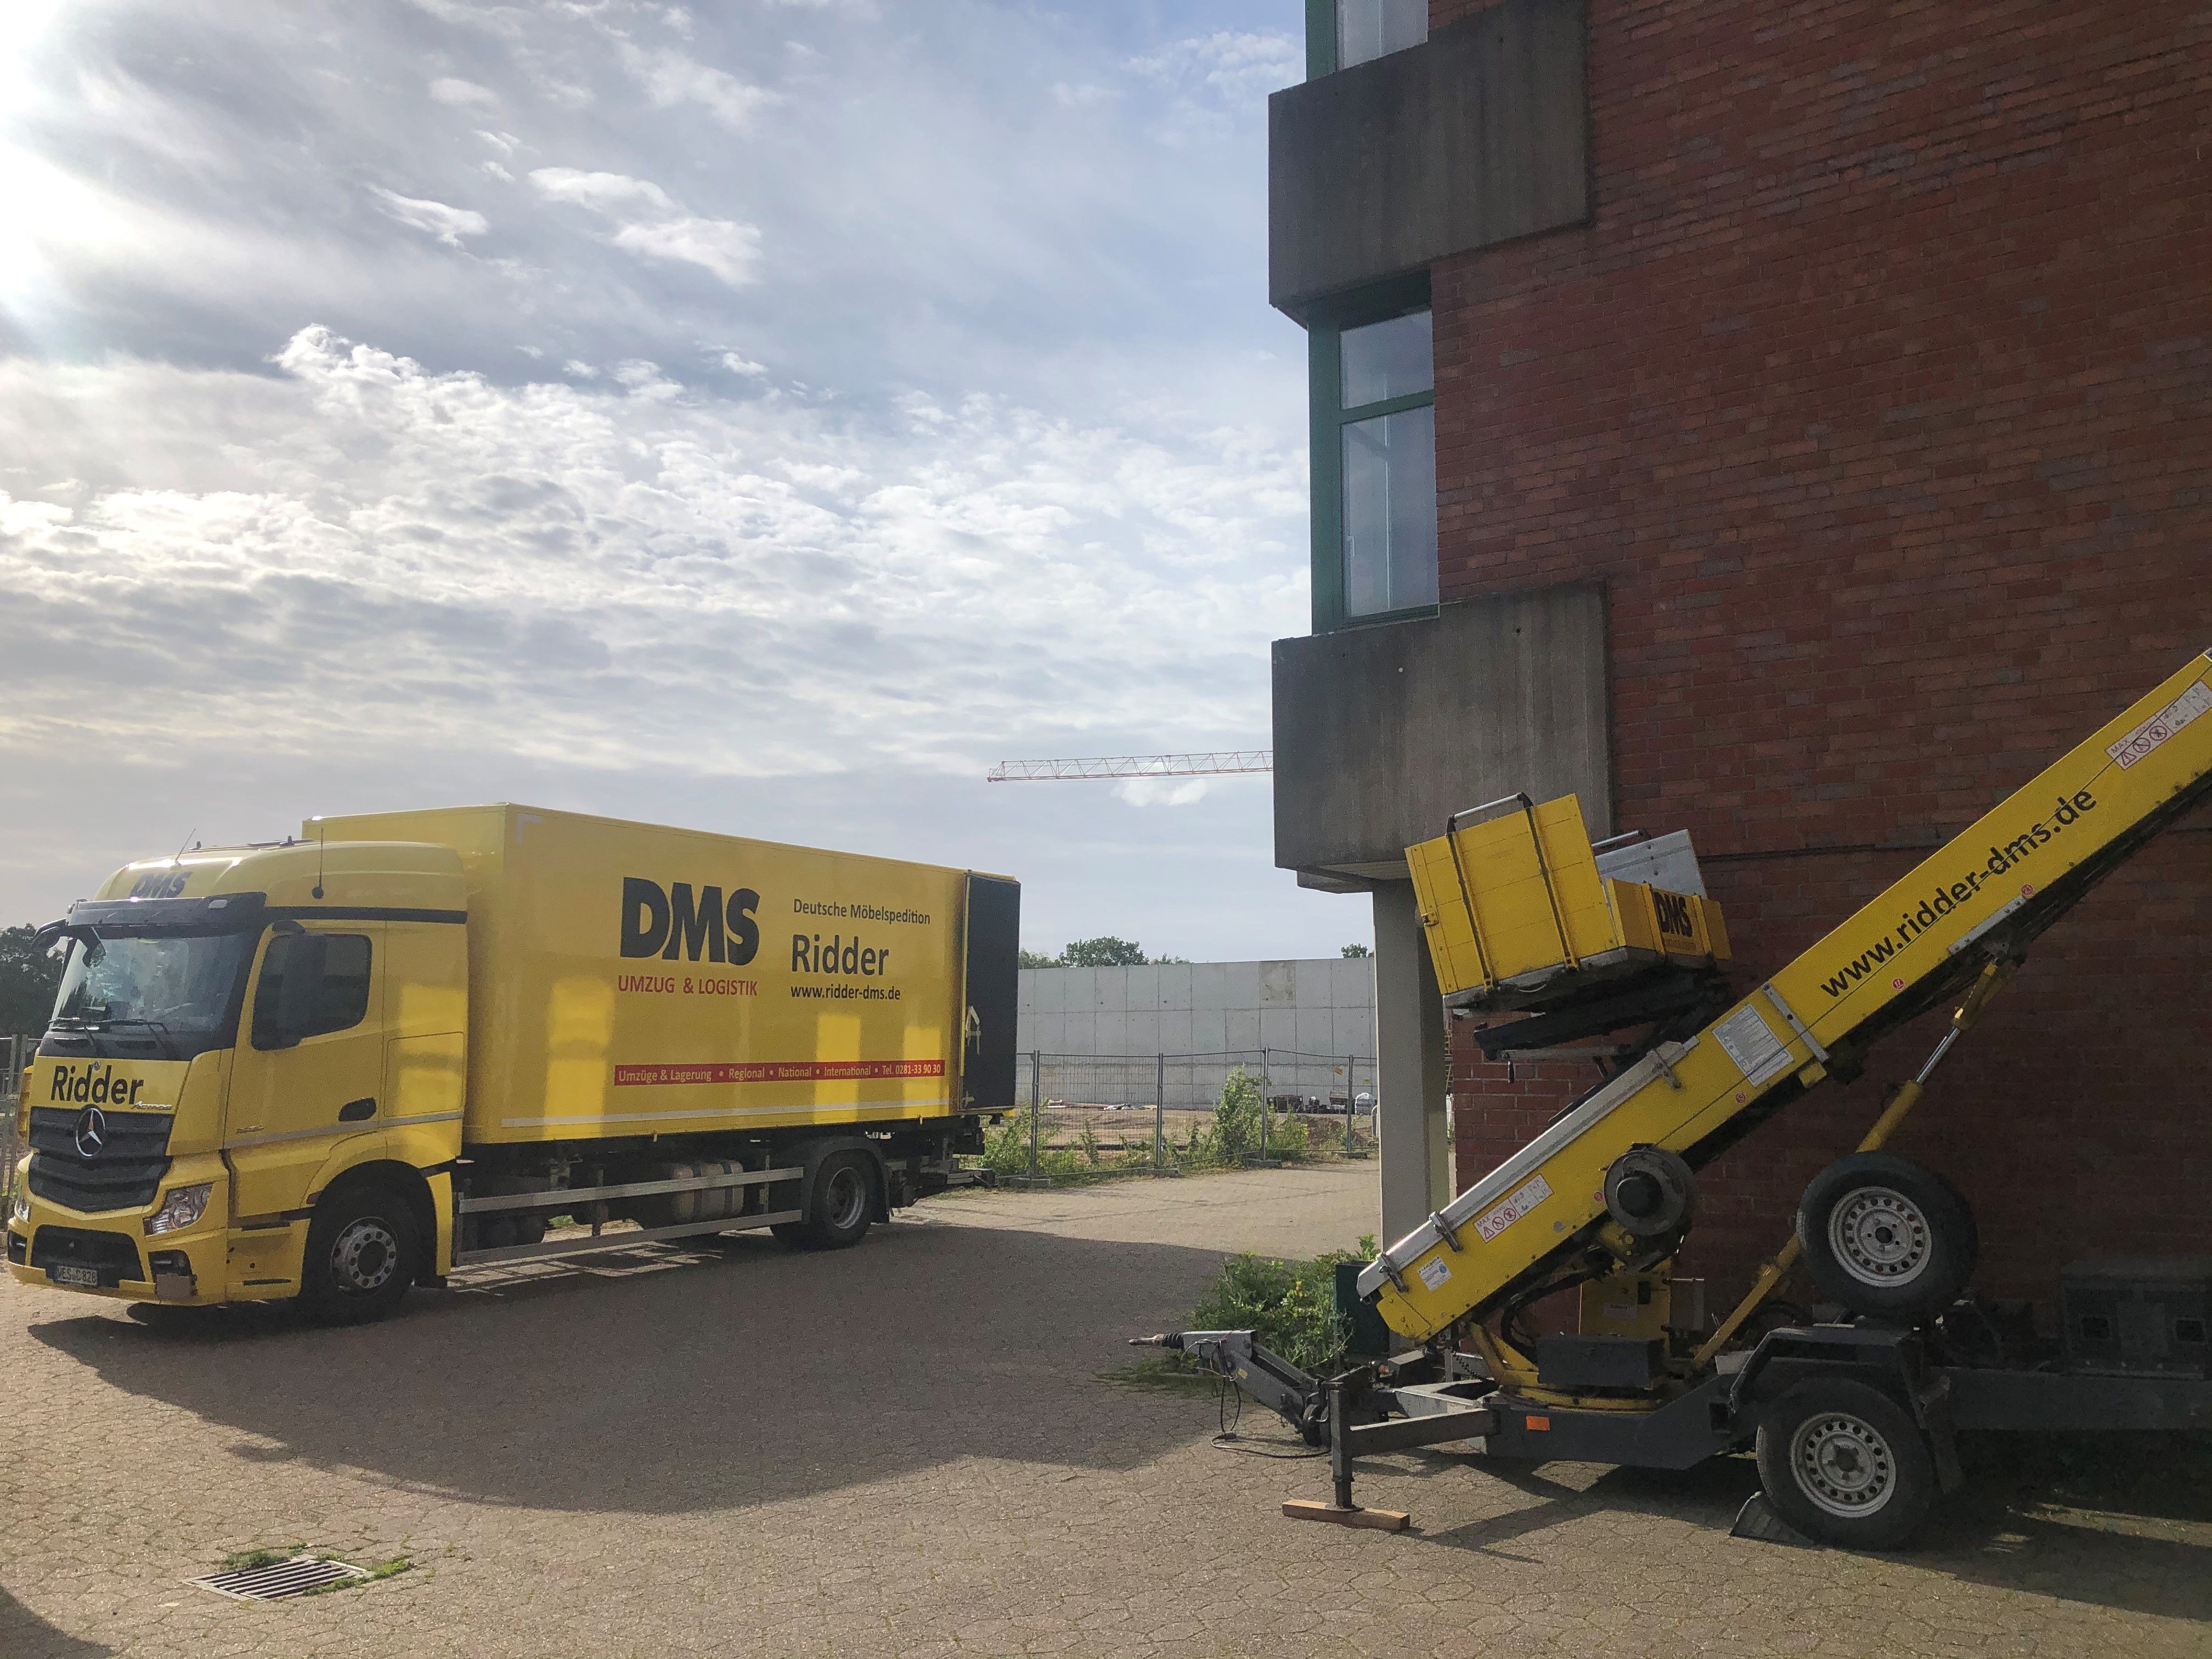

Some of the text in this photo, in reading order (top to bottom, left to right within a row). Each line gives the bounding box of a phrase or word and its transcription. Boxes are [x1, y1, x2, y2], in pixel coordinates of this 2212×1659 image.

[129, 871, 193, 898] DMS
[1821, 791, 2097, 997] www.ridder-dms.de
[619, 877, 760, 966] DMS
[794, 898, 930, 925] Deutsche Möbelspedition
[1654, 891, 1693, 938] DMS
[792, 934, 889, 976] Ridder
[618, 974, 758, 996] UMZUG & LOGISTIK
[790, 984, 901, 1000] www.ridder-dms.de
[50, 1064, 144, 1105] Ridder
[619, 1070, 658, 1084] Umzüge
[660, 1069, 668, 1081] &
[670, 1069, 712, 1083] Lagerung
[729, 1066, 765, 1081] Regional
[778, 1066, 812, 1078] National
[824, 1065, 871, 1077] International
[882, 1065, 894, 1075] Tel.
